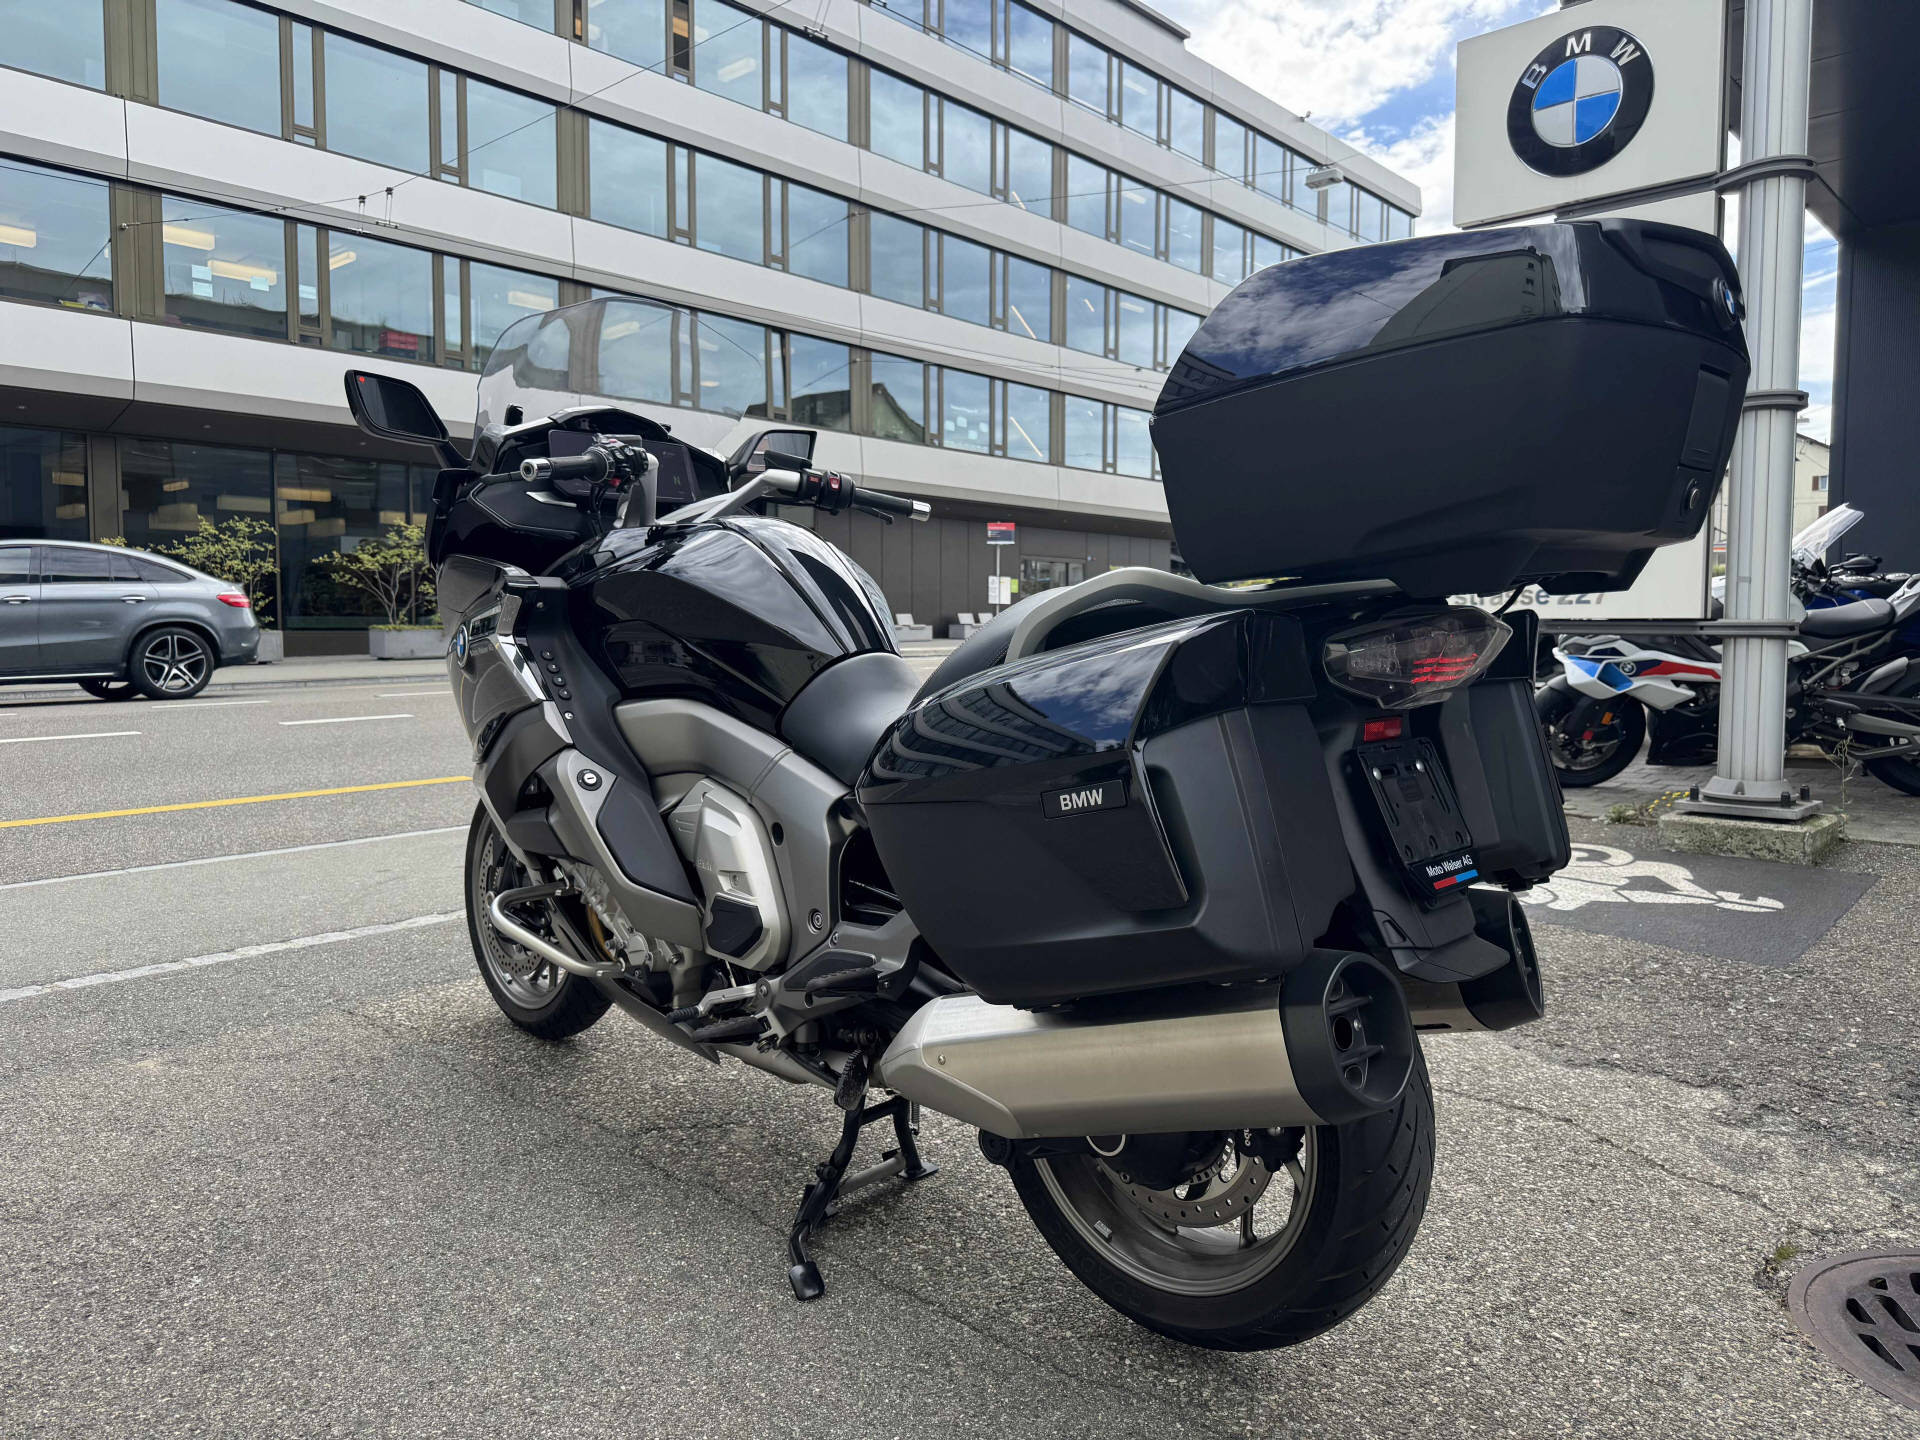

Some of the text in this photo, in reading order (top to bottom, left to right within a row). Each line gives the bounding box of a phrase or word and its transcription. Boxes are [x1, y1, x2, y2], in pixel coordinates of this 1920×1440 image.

[1521, 31, 1641, 89] BMW
[1059, 788, 1103, 811] BMW
[1425, 865, 1444, 877] Moto
[1461, 854, 1473, 866] AG
